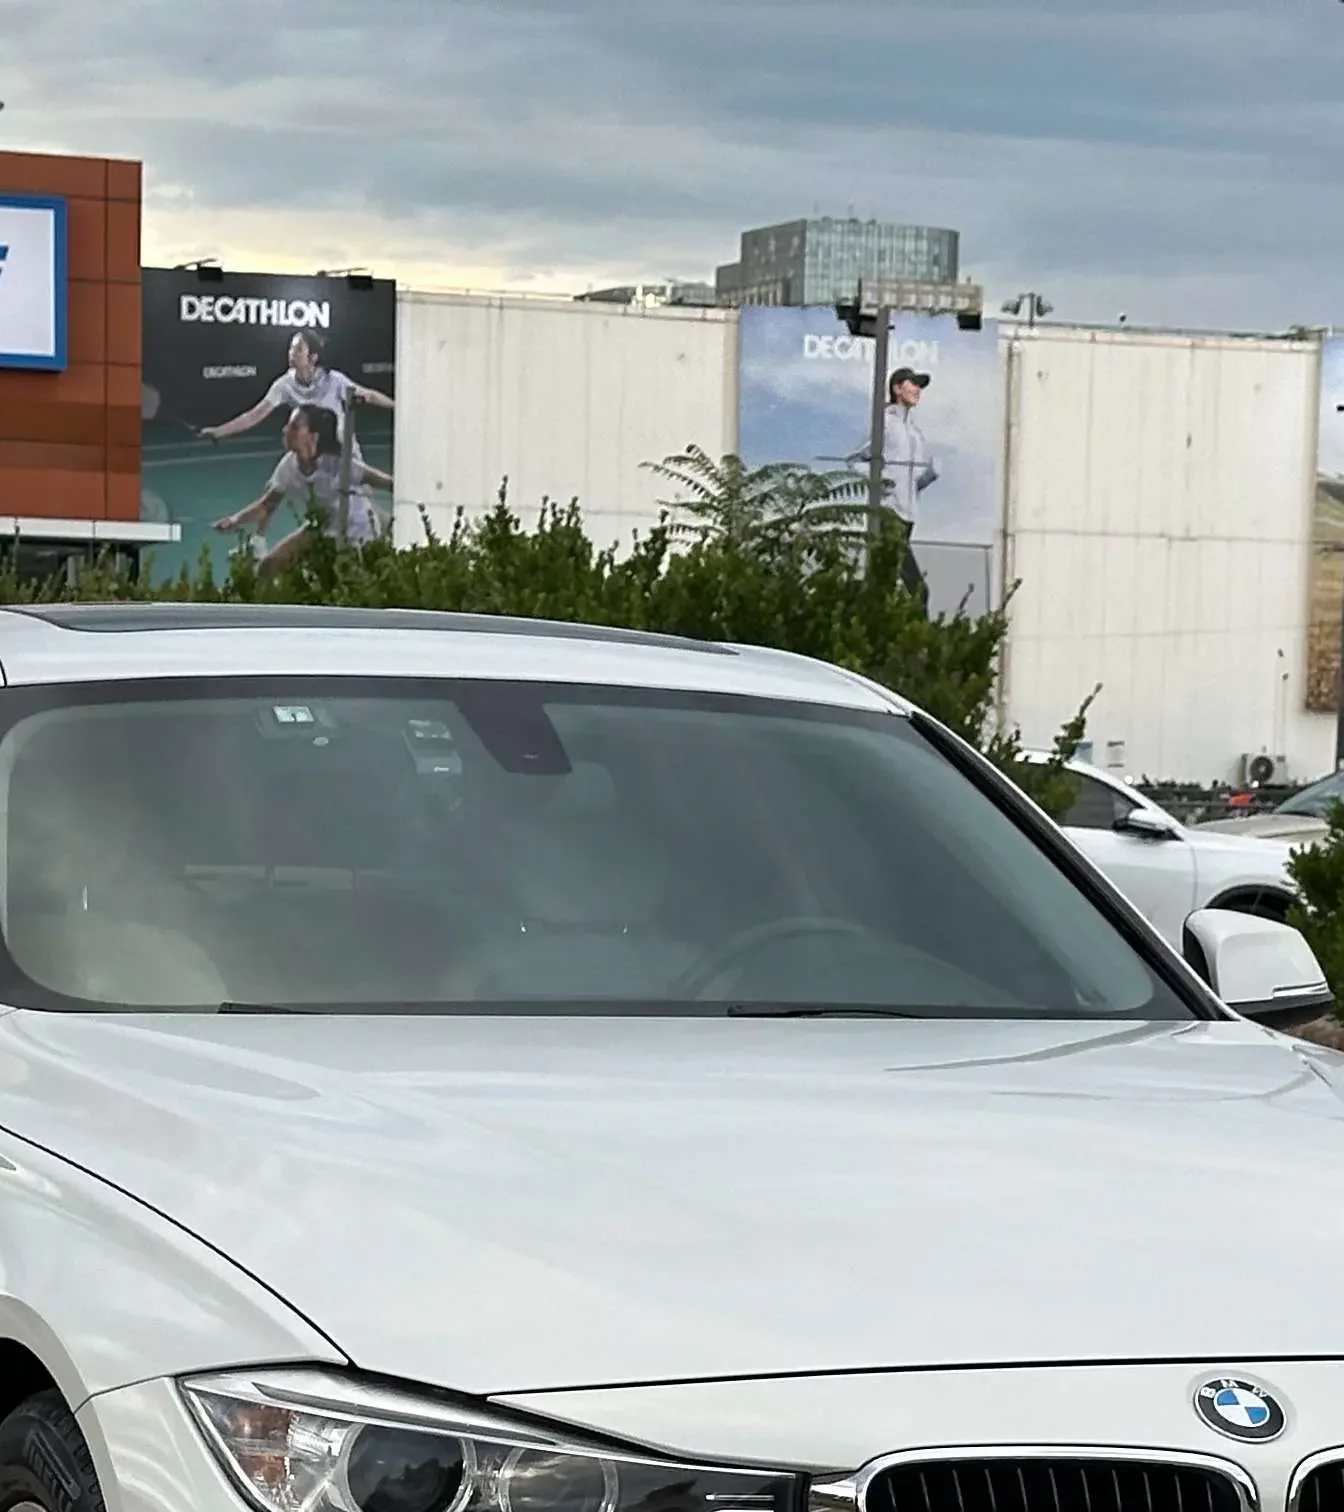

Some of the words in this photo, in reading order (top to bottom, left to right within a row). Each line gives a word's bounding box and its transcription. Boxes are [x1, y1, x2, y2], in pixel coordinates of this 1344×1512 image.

[180, 294, 331, 328] DECATHLON
[803, 334, 940, 365] DECATLON
[1200, 1379, 1268, 1399] BMW
